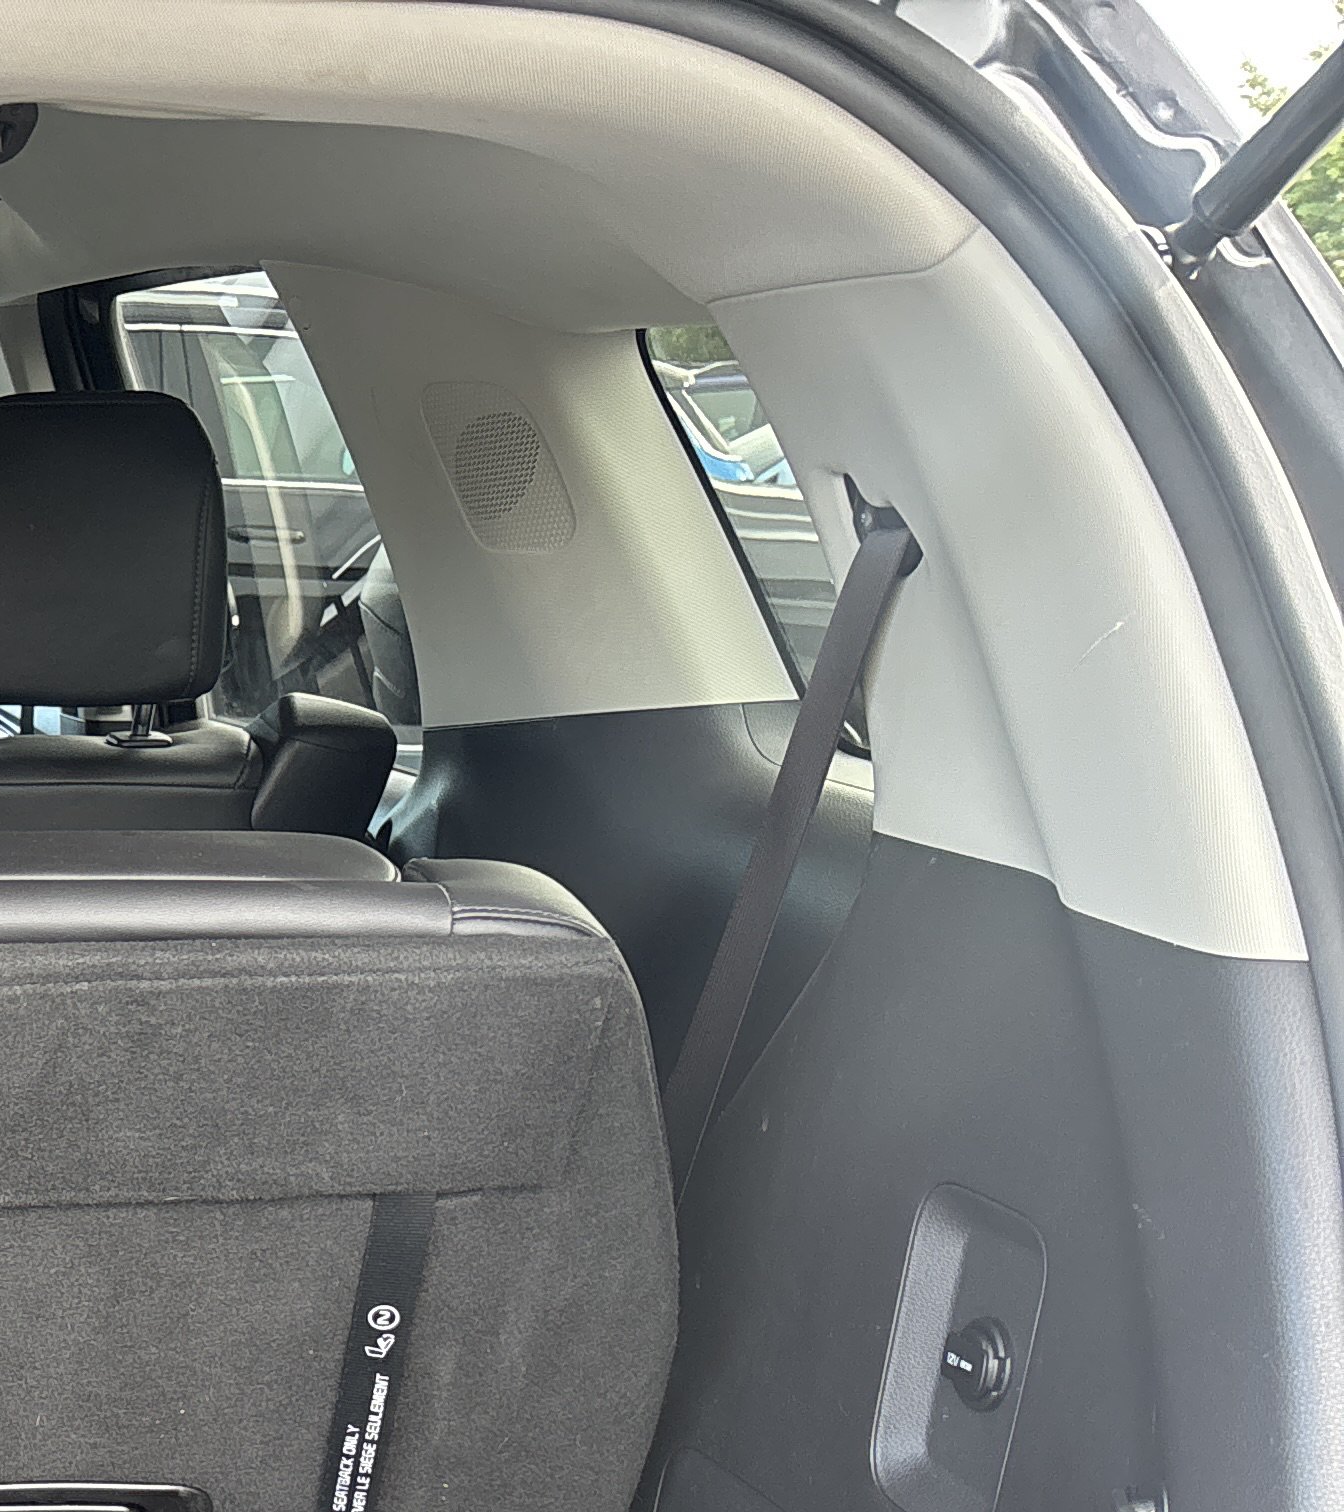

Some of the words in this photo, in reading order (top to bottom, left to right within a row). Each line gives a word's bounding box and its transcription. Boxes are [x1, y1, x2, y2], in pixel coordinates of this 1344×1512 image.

[342, 1423, 360, 1456] ONLY
[355, 1475, 371, 1490] LE
[364, 1372, 390, 1442] SEULEMENT
[332, 1456, 355, 1512] SEATBACK
